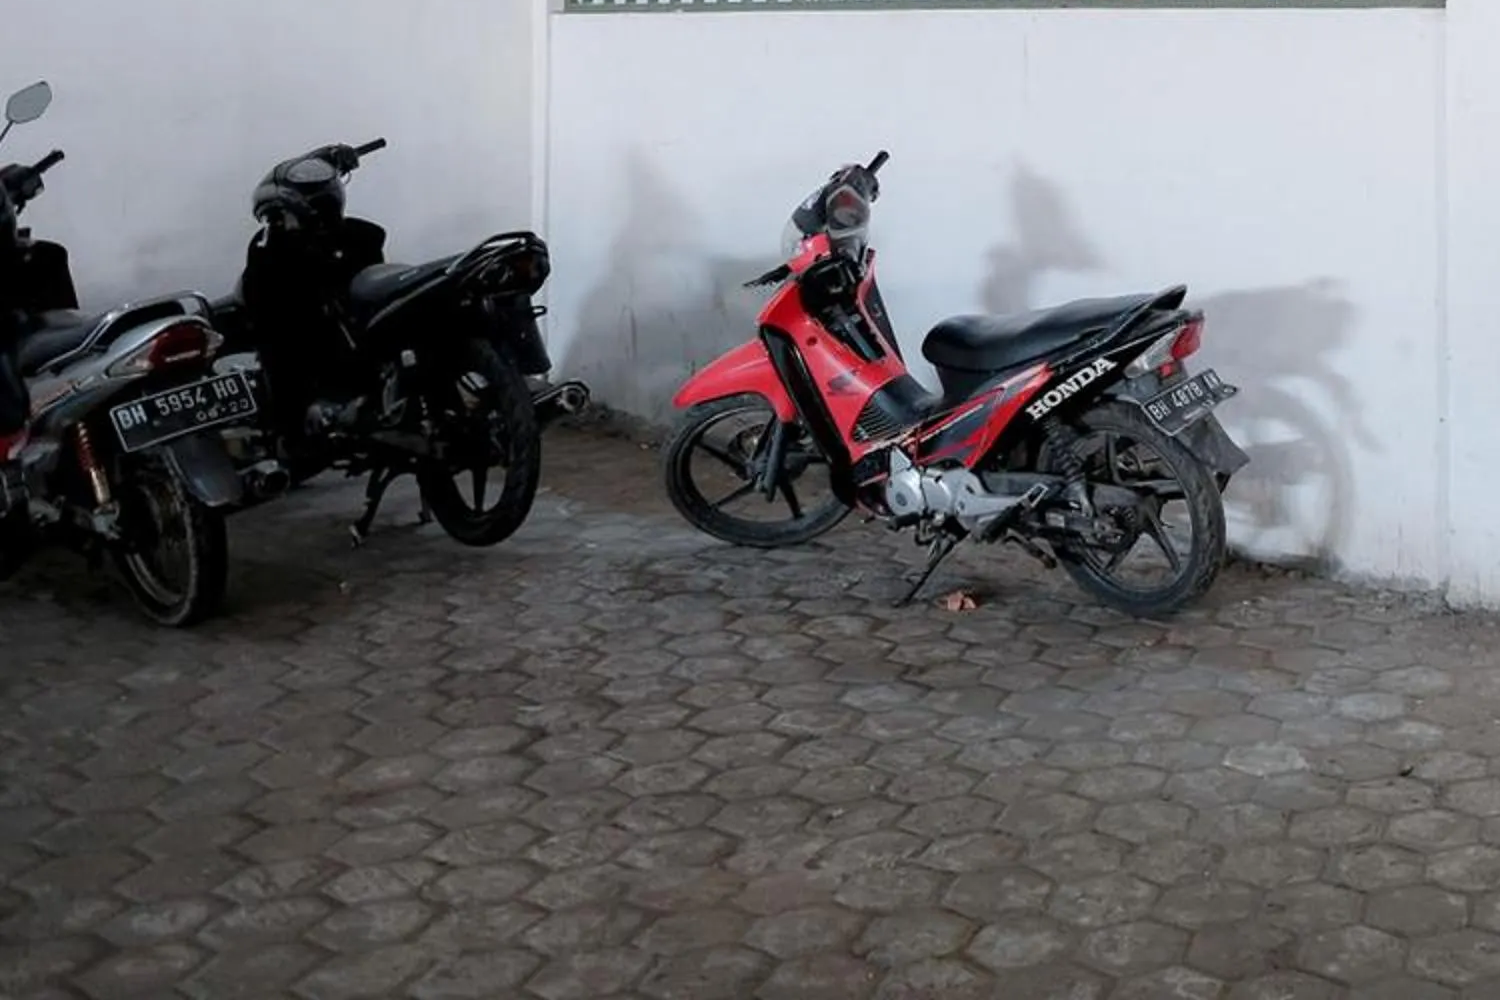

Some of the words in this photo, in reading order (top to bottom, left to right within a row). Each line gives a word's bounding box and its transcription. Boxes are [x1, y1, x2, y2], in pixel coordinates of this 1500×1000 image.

[117, 404, 148, 430] BH
[154, 388, 207, 416] 5954
[1026, 356, 1118, 420] HONDA
